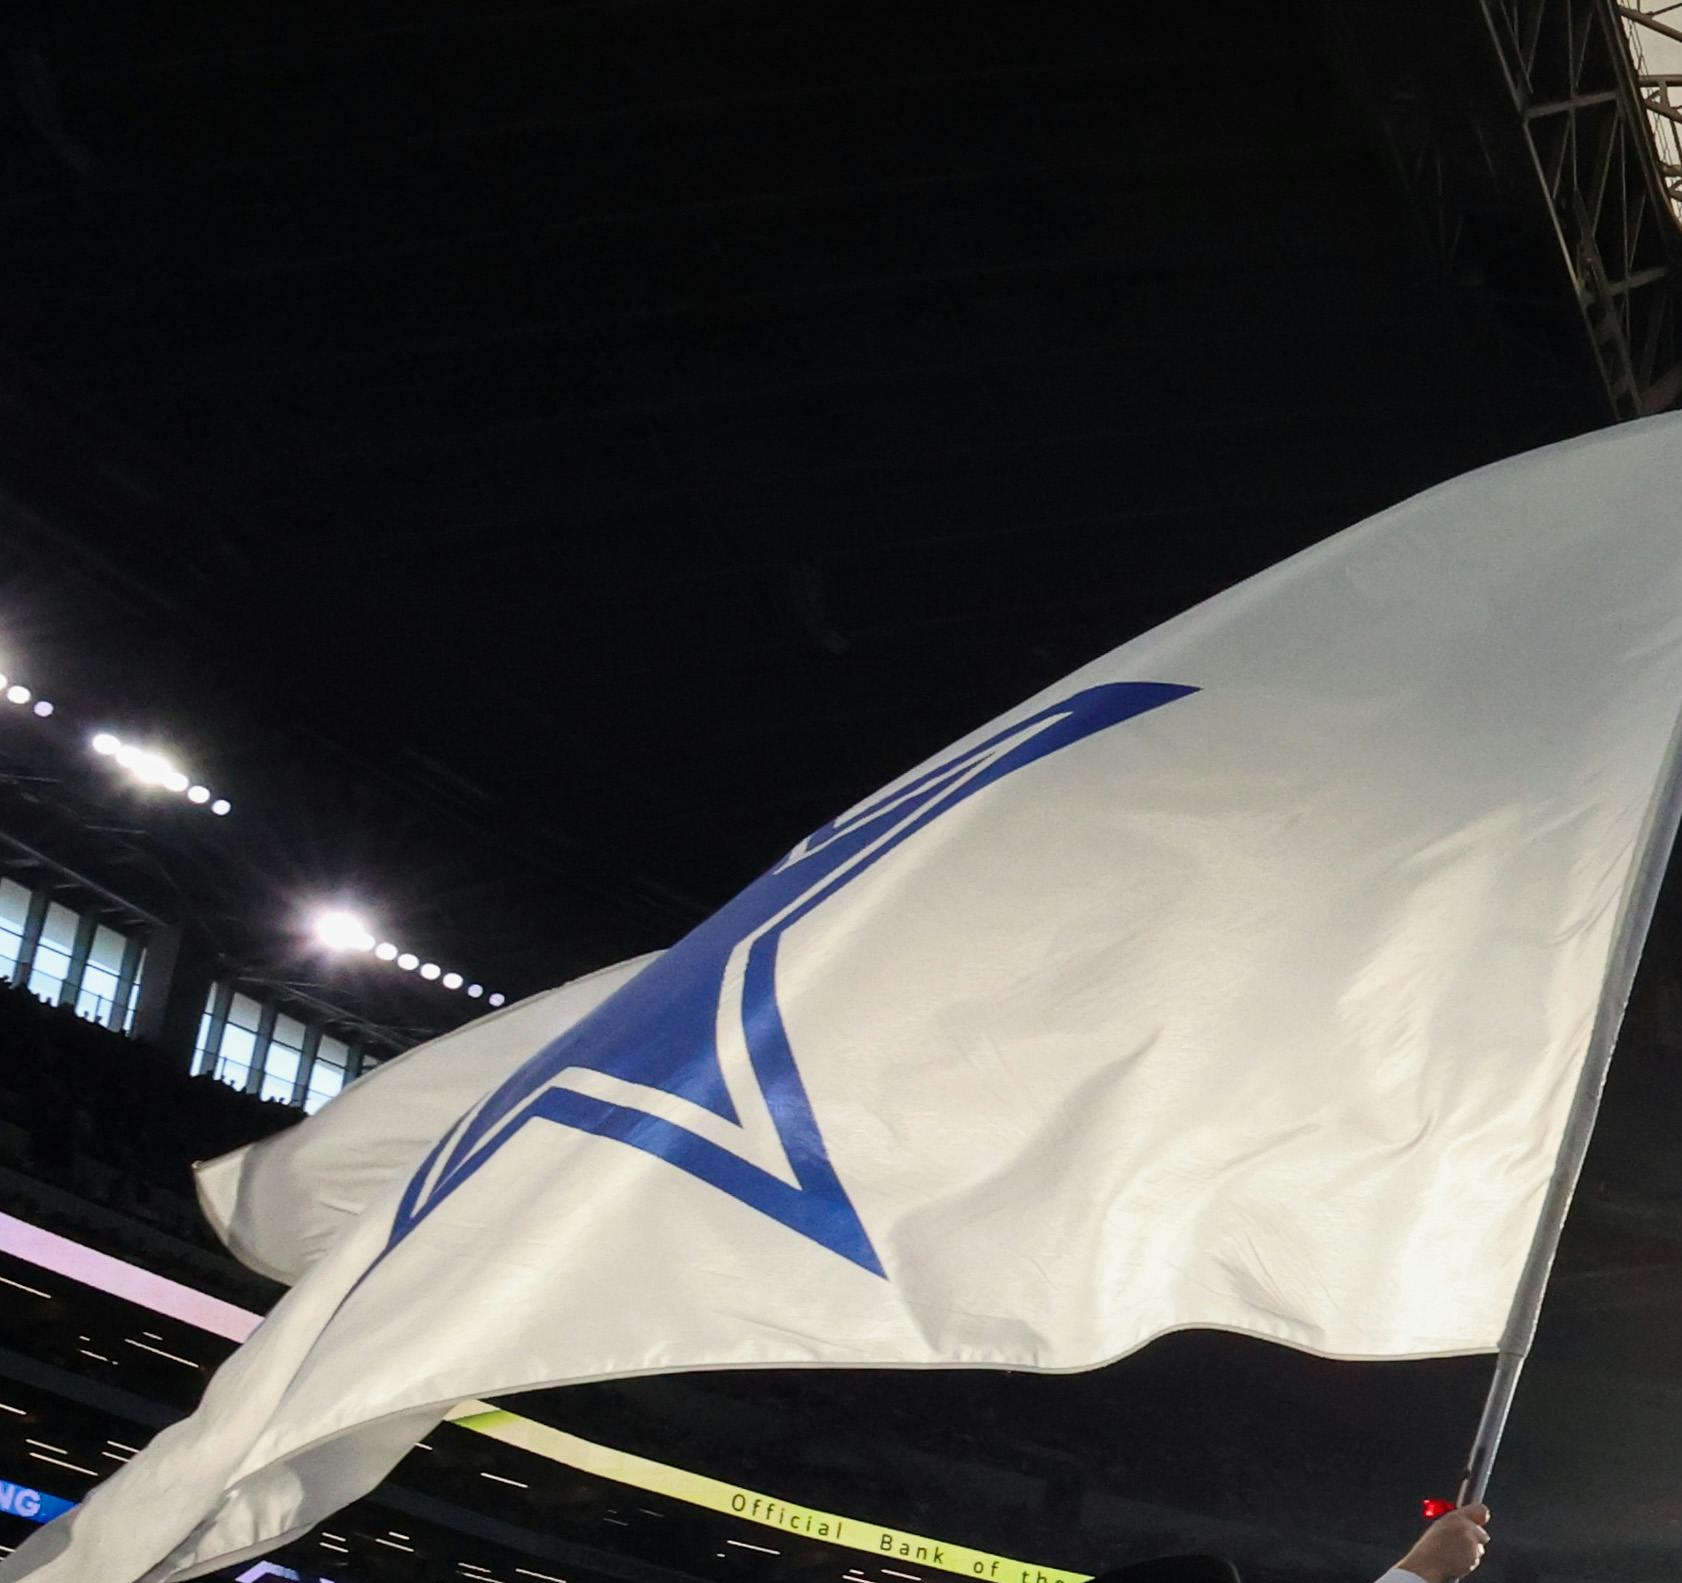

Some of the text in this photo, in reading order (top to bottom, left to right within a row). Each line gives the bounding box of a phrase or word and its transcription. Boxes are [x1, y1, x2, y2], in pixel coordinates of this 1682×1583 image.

[731, 1493, 844, 1540] Official
[879, 1533, 945, 1565] Bank
[973, 1558, 1000, 1578] of
